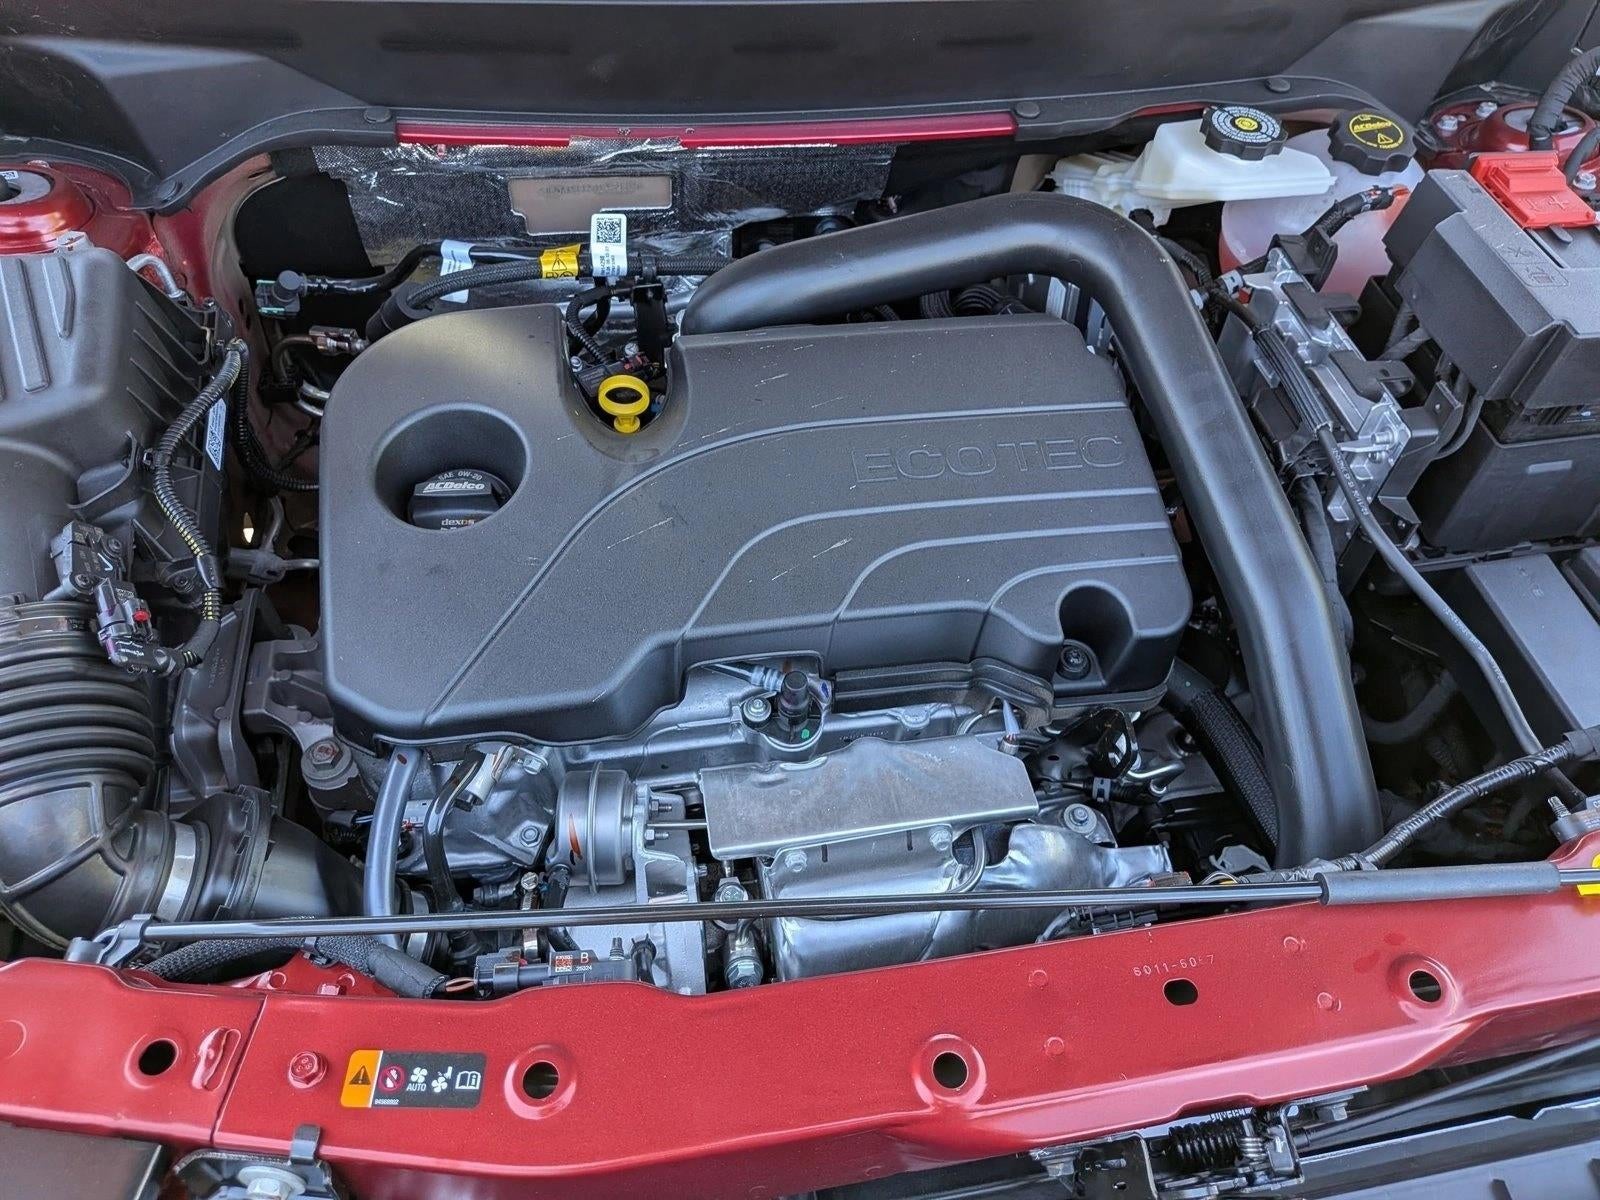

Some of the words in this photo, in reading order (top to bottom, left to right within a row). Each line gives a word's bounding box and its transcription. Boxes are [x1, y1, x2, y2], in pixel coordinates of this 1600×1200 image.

[850, 436, 1126, 483] ECOTEC
[438, 470, 454, 481] SAE
[457, 470, 483, 481] 0W-20
[423, 481, 485, 493] ACDelco
[441, 518, 475, 526] dexos
[580, 952, 589, 964] B
[1133, 954, 1214, 976] 6011-607
[406, 1083, 427, 1092] AUTO
